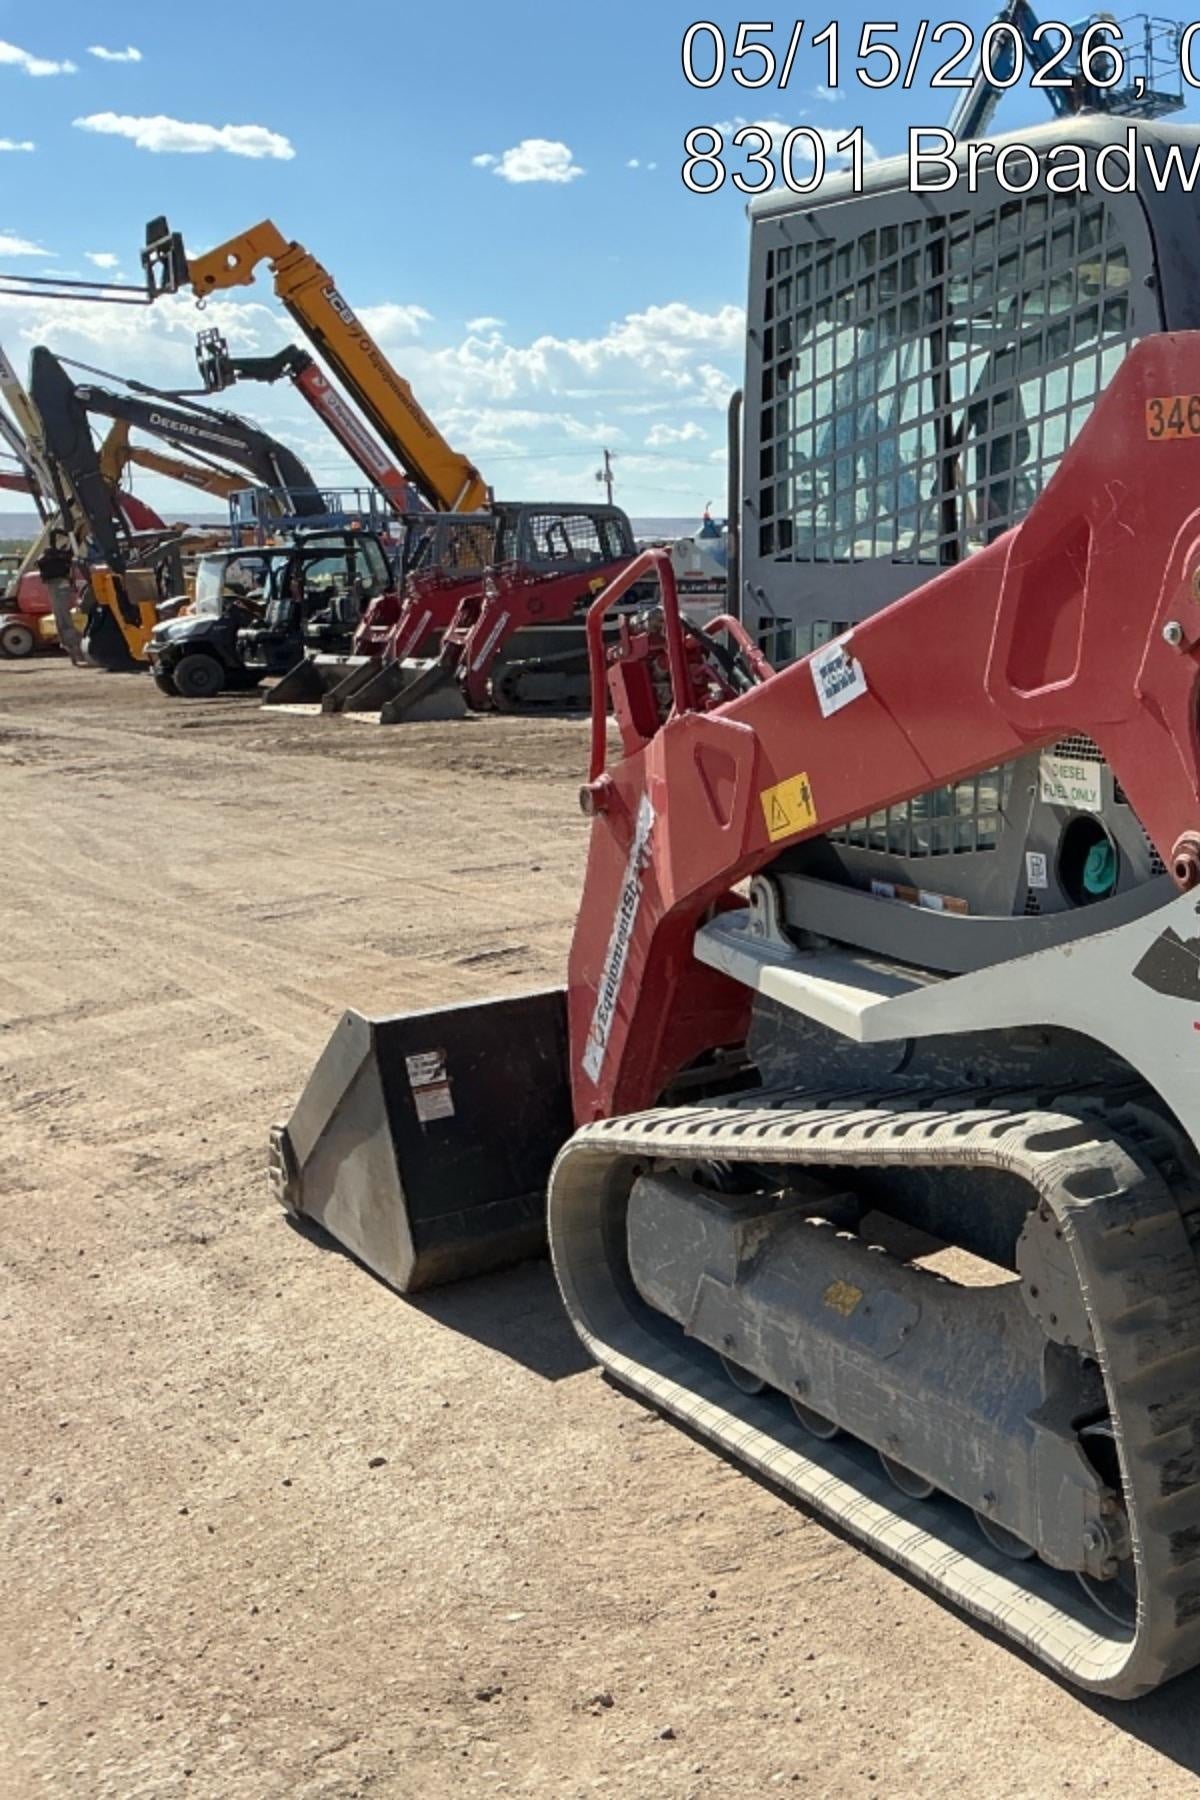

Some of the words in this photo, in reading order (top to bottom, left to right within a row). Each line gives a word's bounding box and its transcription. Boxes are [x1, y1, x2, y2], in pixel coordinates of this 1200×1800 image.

[321, 285, 355, 327] JCB
[149, 412, 200, 436] DEERE
[1051, 762, 1088, 781] DIESEL
[1043, 782, 1069, 800] FUEL
[1070, 786, 1097, 803] ONLY
